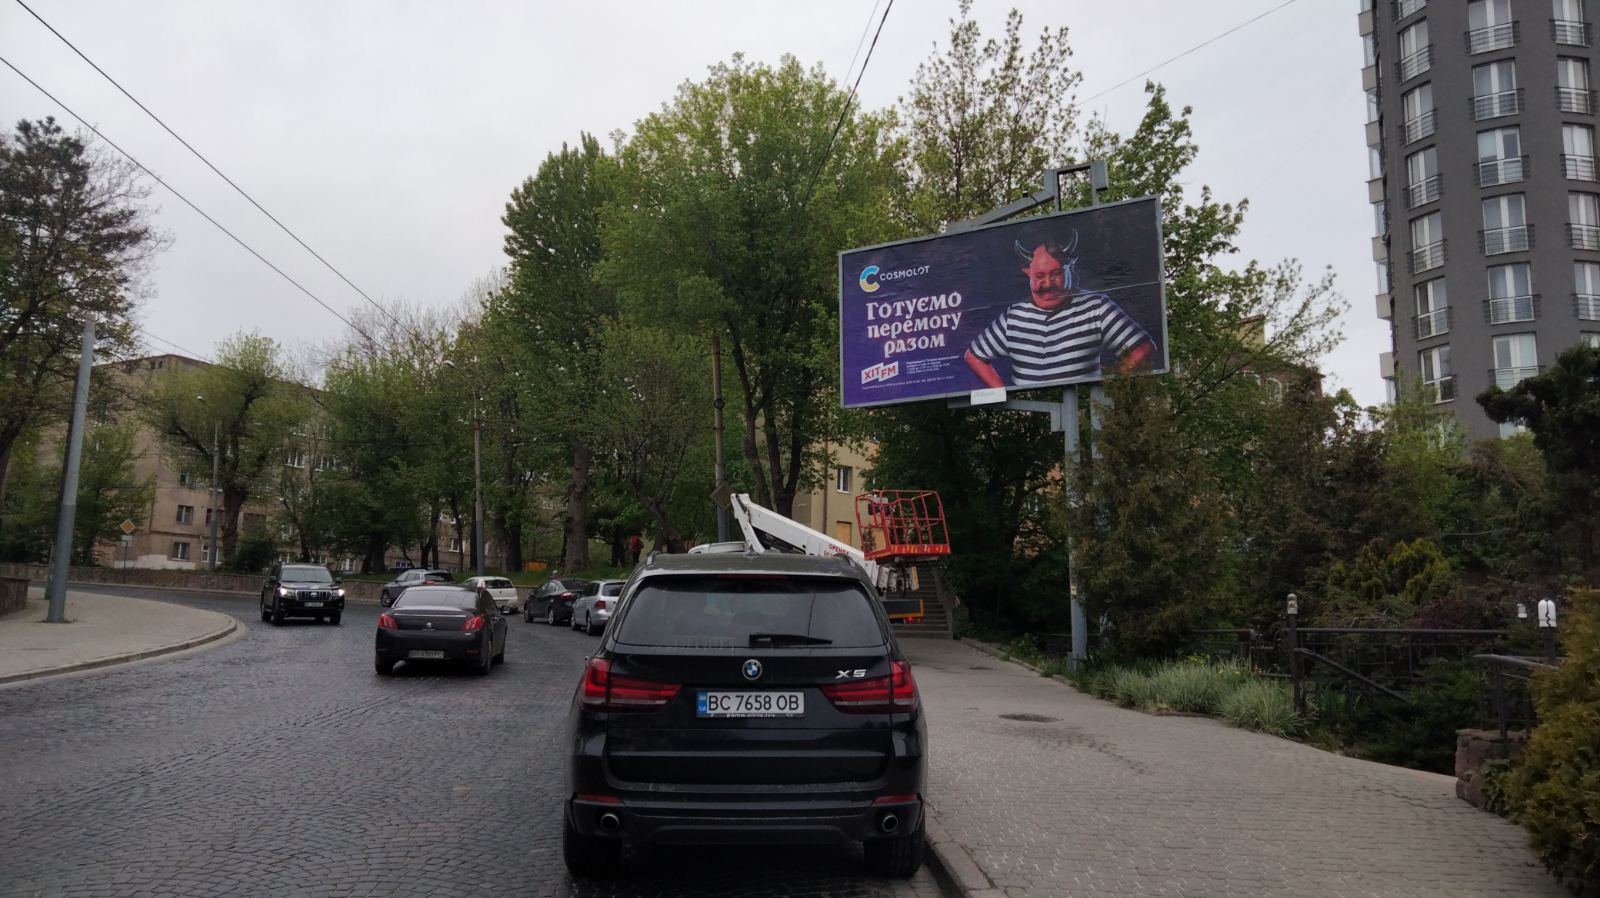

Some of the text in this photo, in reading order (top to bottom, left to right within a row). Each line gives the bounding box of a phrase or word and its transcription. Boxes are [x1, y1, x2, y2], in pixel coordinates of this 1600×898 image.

[879, 265, 930, 281] COSMOLOT
[866, 291, 962, 320] Готуємо
[867, 312, 962, 338] перемогу
[884, 333, 945, 358] разом
[834, 669, 867, 679] X5
[708, 695, 799, 711] BC 7658 OB
